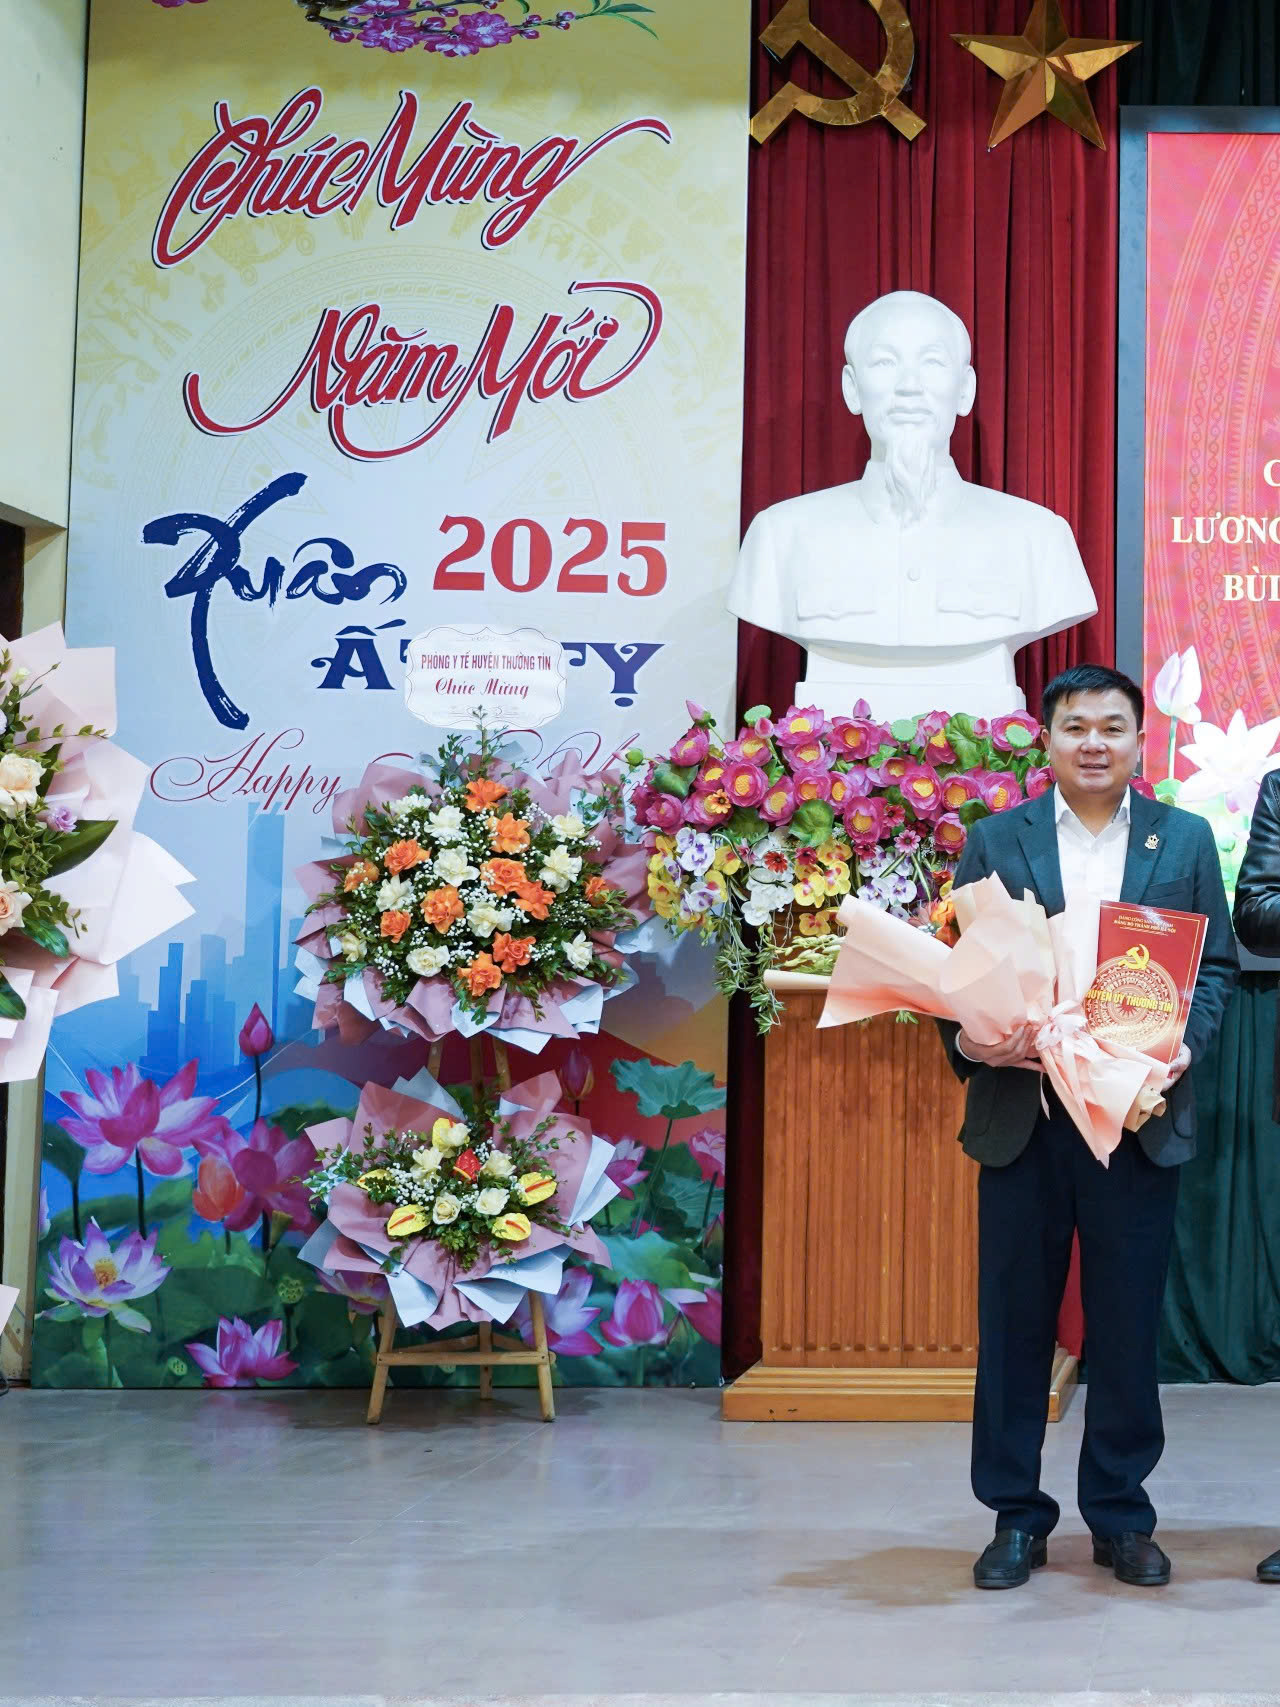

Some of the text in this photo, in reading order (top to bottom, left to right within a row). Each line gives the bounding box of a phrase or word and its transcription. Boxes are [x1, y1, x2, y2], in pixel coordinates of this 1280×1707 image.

[152, 86, 673, 269] Chúc Mừng
[183, 303, 467, 436] Năm
[141, 471, 668, 729] Xuân 2025
[1222, 565, 1280, 602] BÙI
[310, 619, 413, 690] Ấ
[435, 677, 475, 695] Chúc
[453, 655, 458, 669] Y
[460, 650, 470, 669] TẾ
[472, 651, 499, 672] HUYỆN
[502, 652, 535, 670] THƯỜNG
[150, 728, 341, 814] Happy
